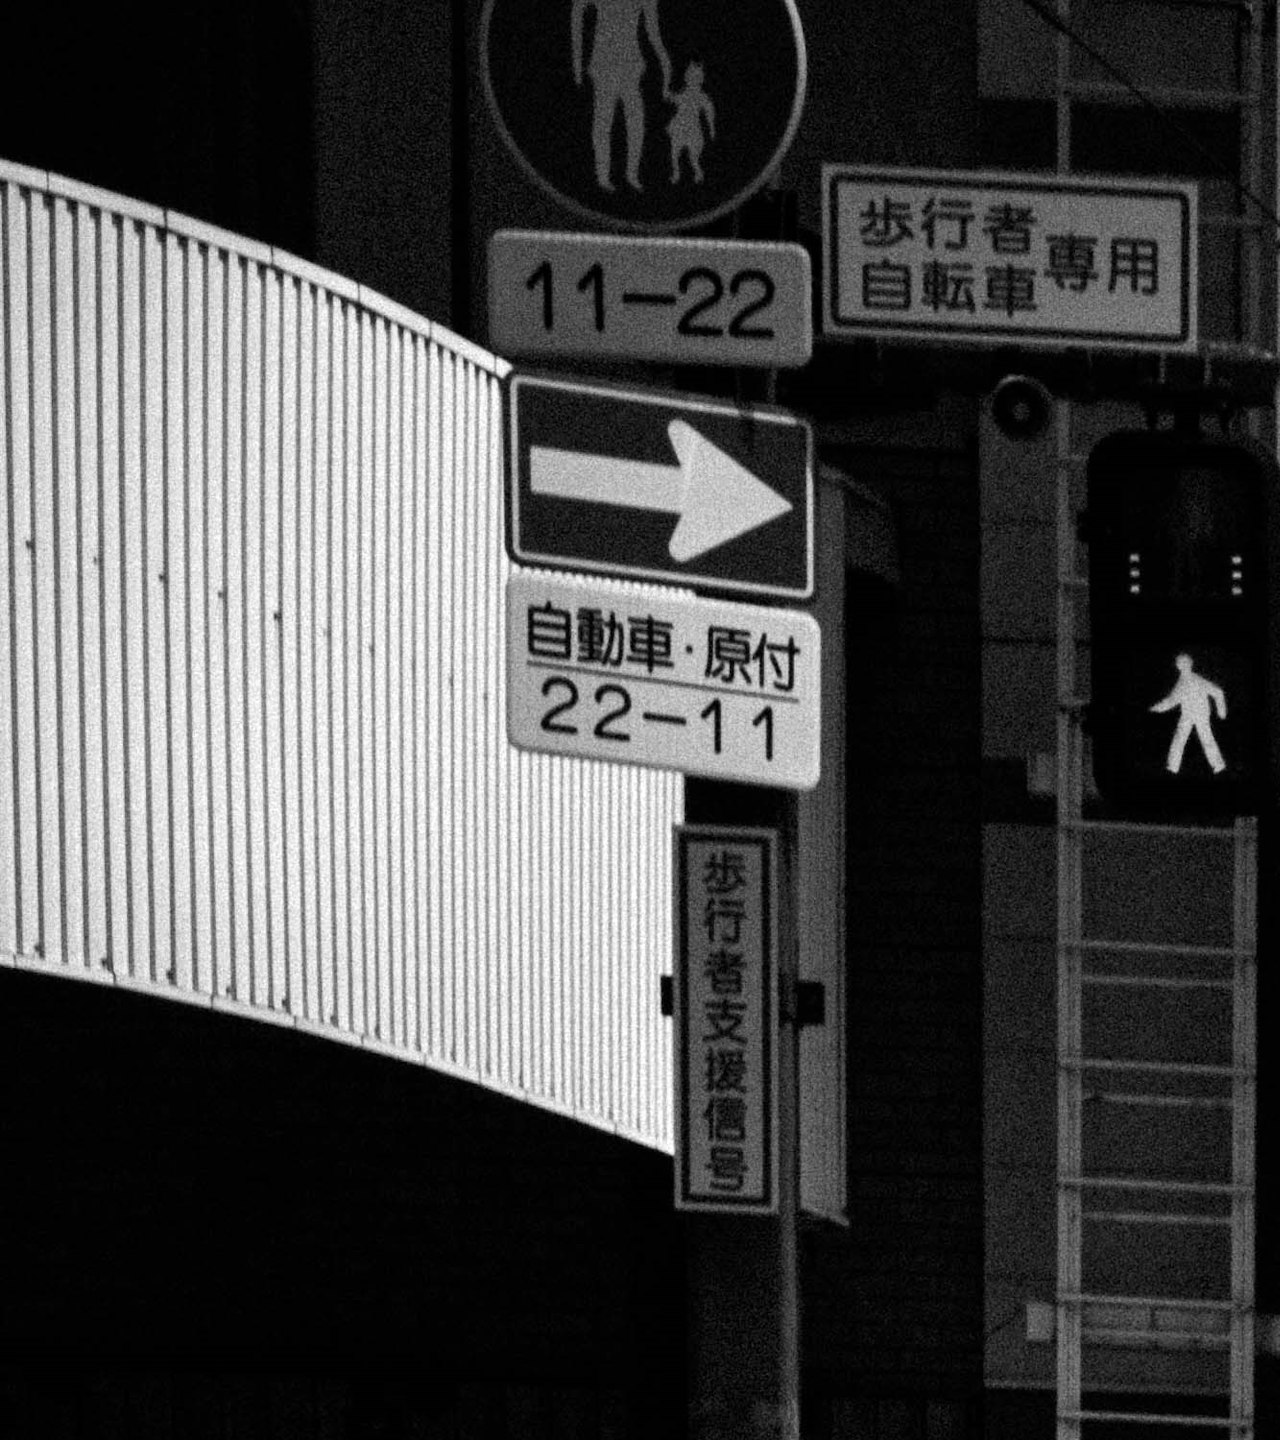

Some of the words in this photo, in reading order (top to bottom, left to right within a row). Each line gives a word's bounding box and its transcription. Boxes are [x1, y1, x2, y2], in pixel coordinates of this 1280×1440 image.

[858, 197, 1039, 255] 歩行者
[527, 260, 775, 338] 11-22
[860, 258, 1038, 318] 自転車
[1044, 231, 1159, 296] 専用
[539, 675, 775, 762] 22-11
[702, 850, 749, 1191] 歩行者支援信号
